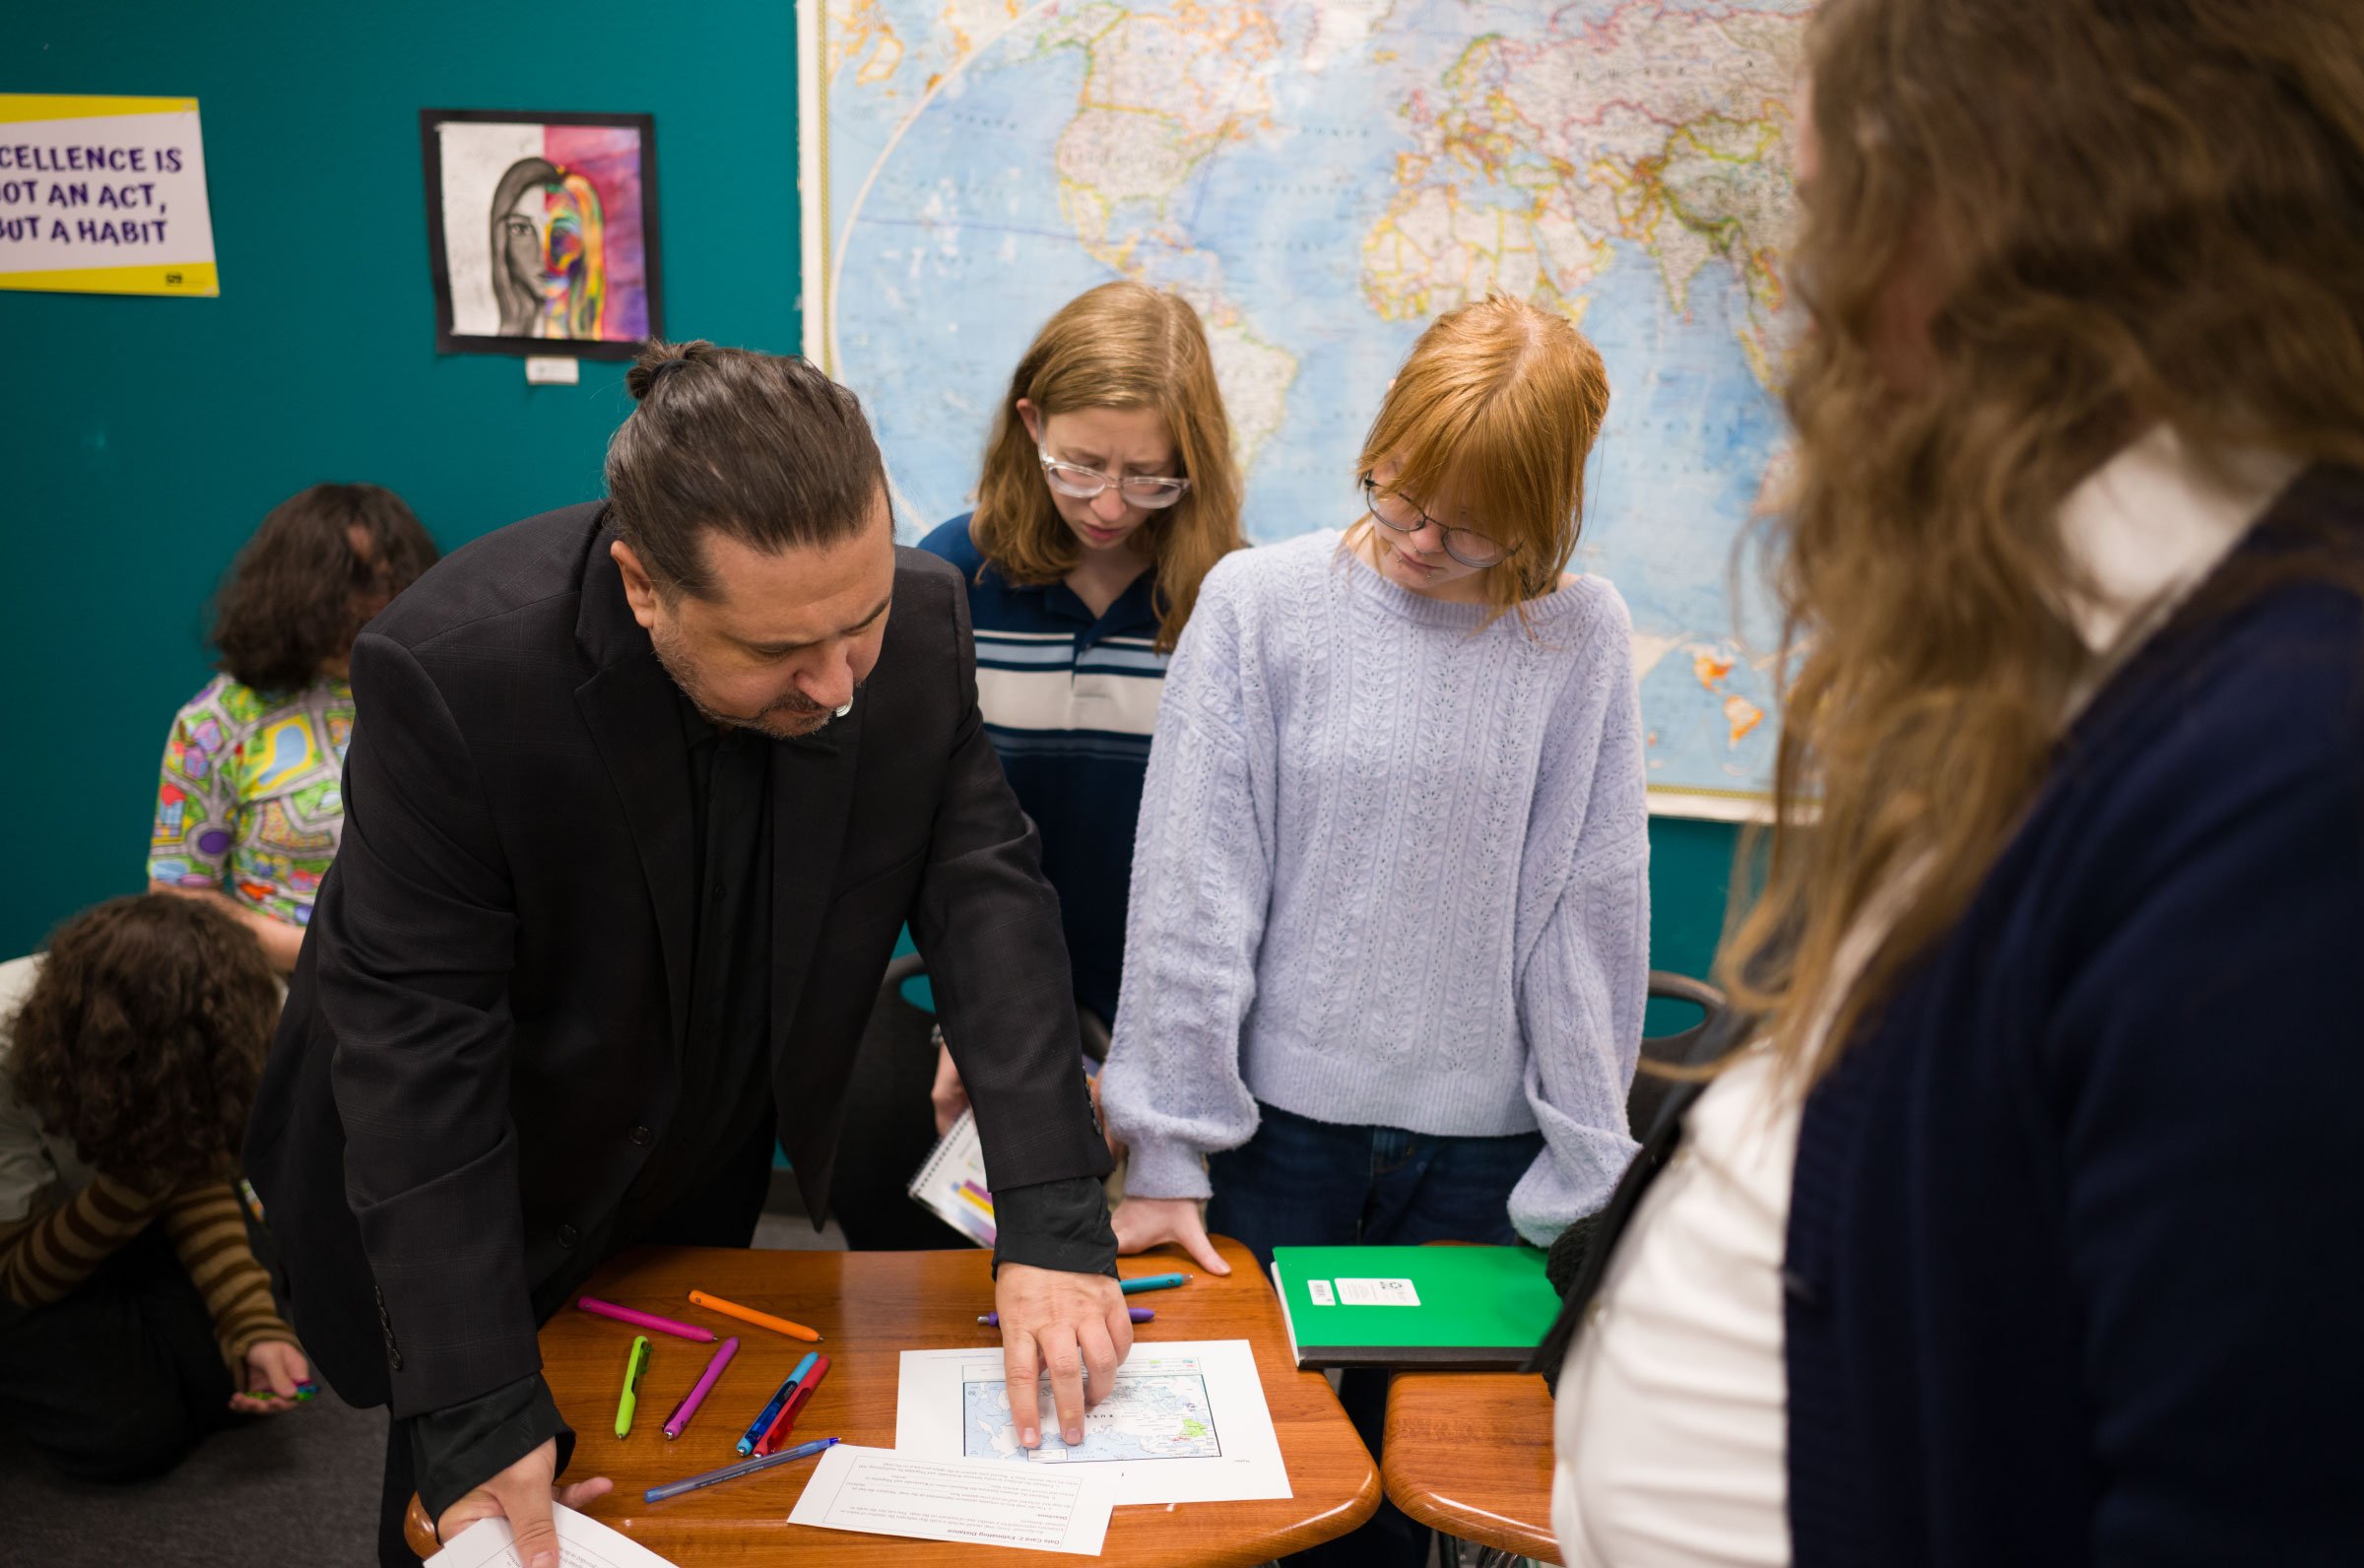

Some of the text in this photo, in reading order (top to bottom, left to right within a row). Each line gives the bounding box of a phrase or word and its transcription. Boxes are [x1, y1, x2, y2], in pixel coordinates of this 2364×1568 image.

[0, 145, 184, 174] CELLENCE IS
[0, 180, 167, 215] OT AN ACT,
[50, 218, 71, 244] A
[77, 220, 168, 246] HABIT
